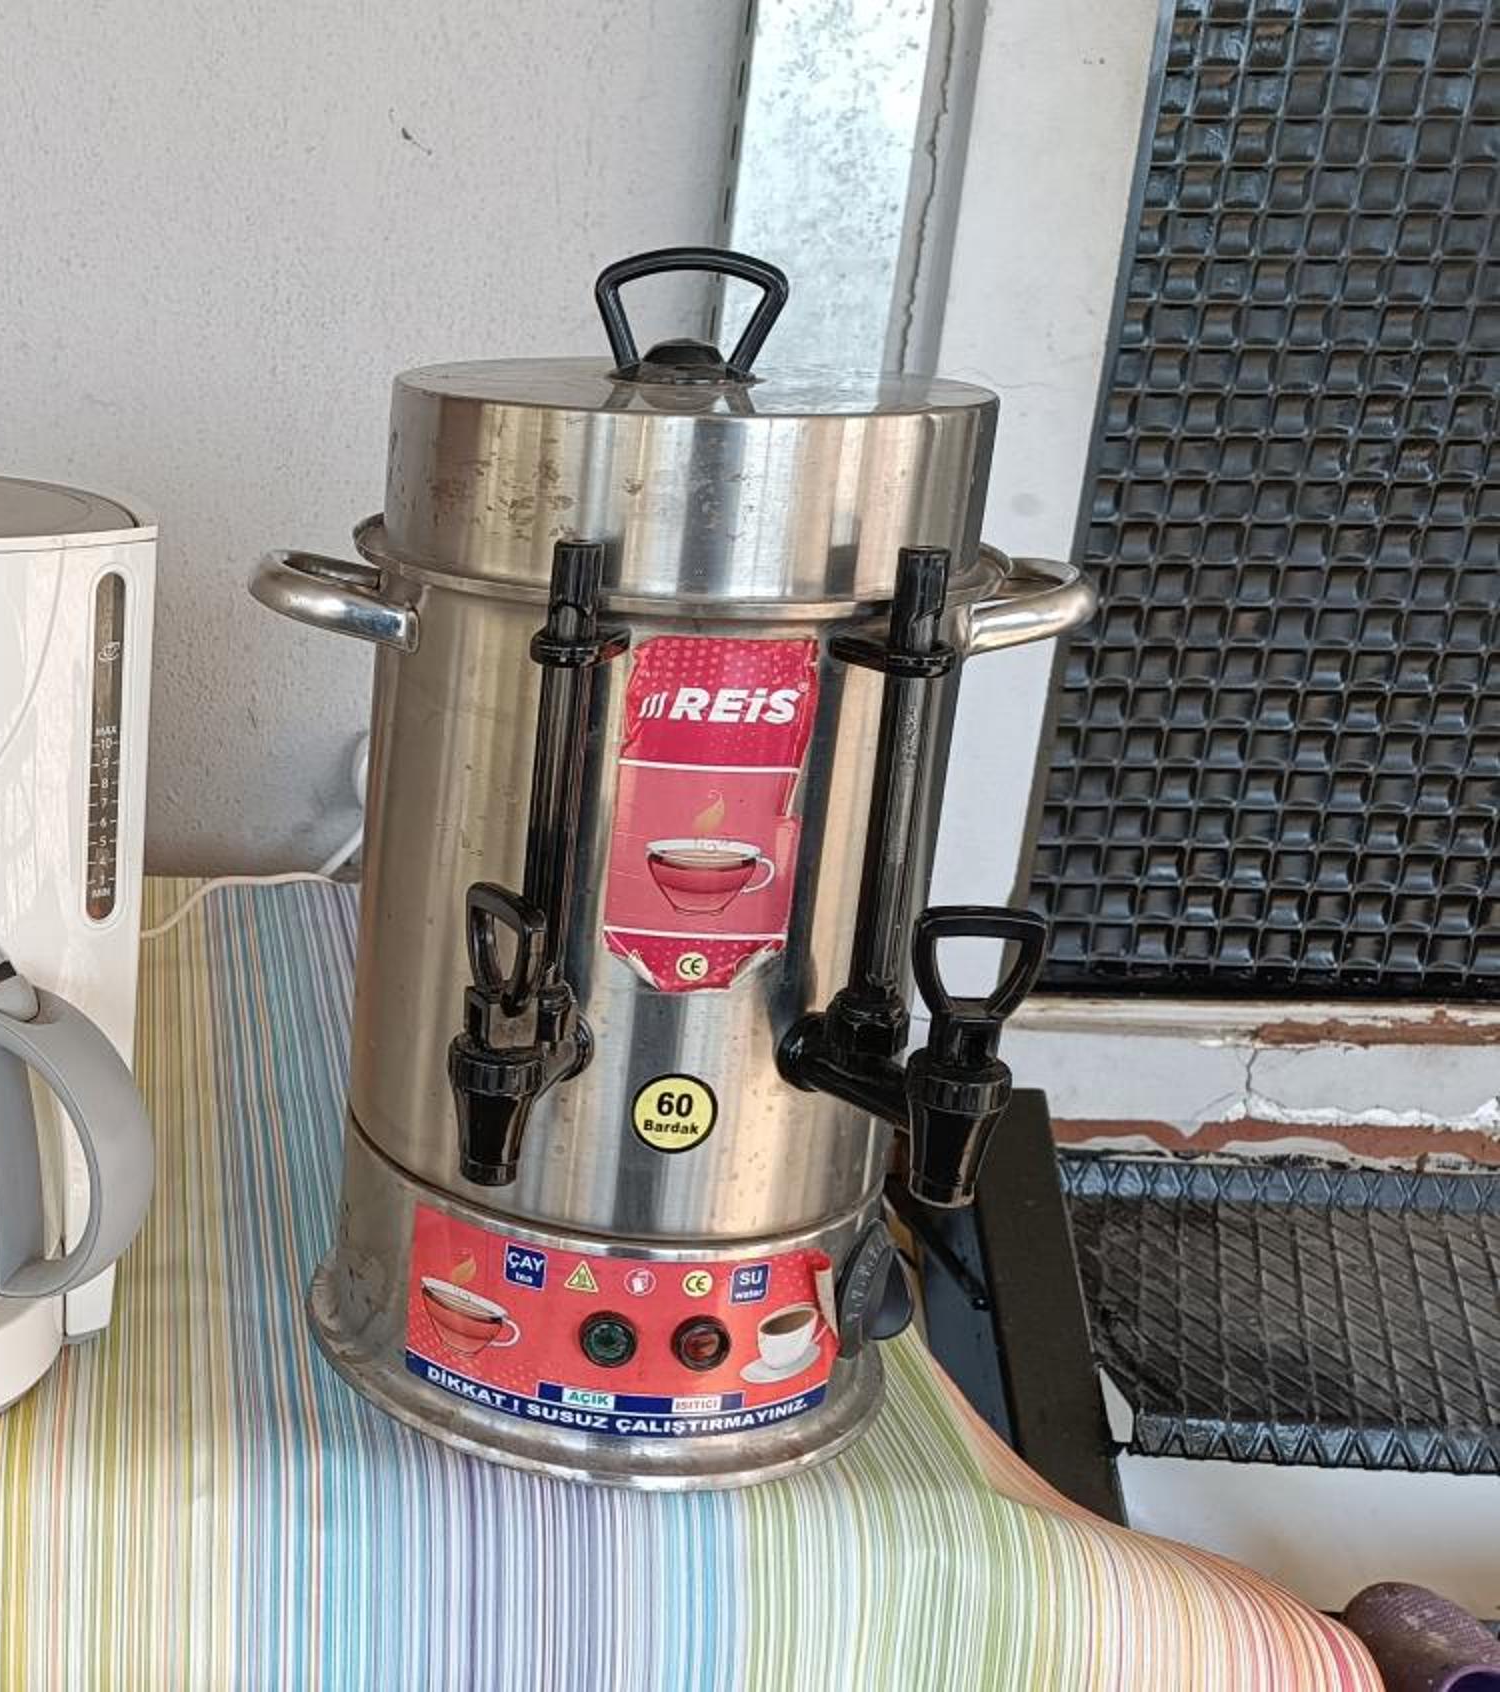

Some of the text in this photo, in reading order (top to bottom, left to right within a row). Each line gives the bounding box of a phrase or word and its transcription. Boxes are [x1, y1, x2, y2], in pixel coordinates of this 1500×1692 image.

[101, 738, 113, 750] 10
[101, 757, 109, 769] 9
[101, 777, 109, 789] 8
[101, 797, 108, 810] 7
[100, 817, 108, 829] 6
[99, 835, 107, 847] 5
[657, 1092, 694, 1118] 60
[643, 1119, 699, 1135] Bardak
[507, 1251, 545, 1272] ÇAY
[515, 1271, 533, 1284] tea
[739, 1269, 763, 1286] SU
[735, 1289, 765, 1300] water
[427, 1365, 507, 1411] DİKKAT
[526, 1402, 609, 1429] SUSUZ
[568, 1391, 610, 1406] AÇIK
[675, 1398, 718, 1411] ISITICI
